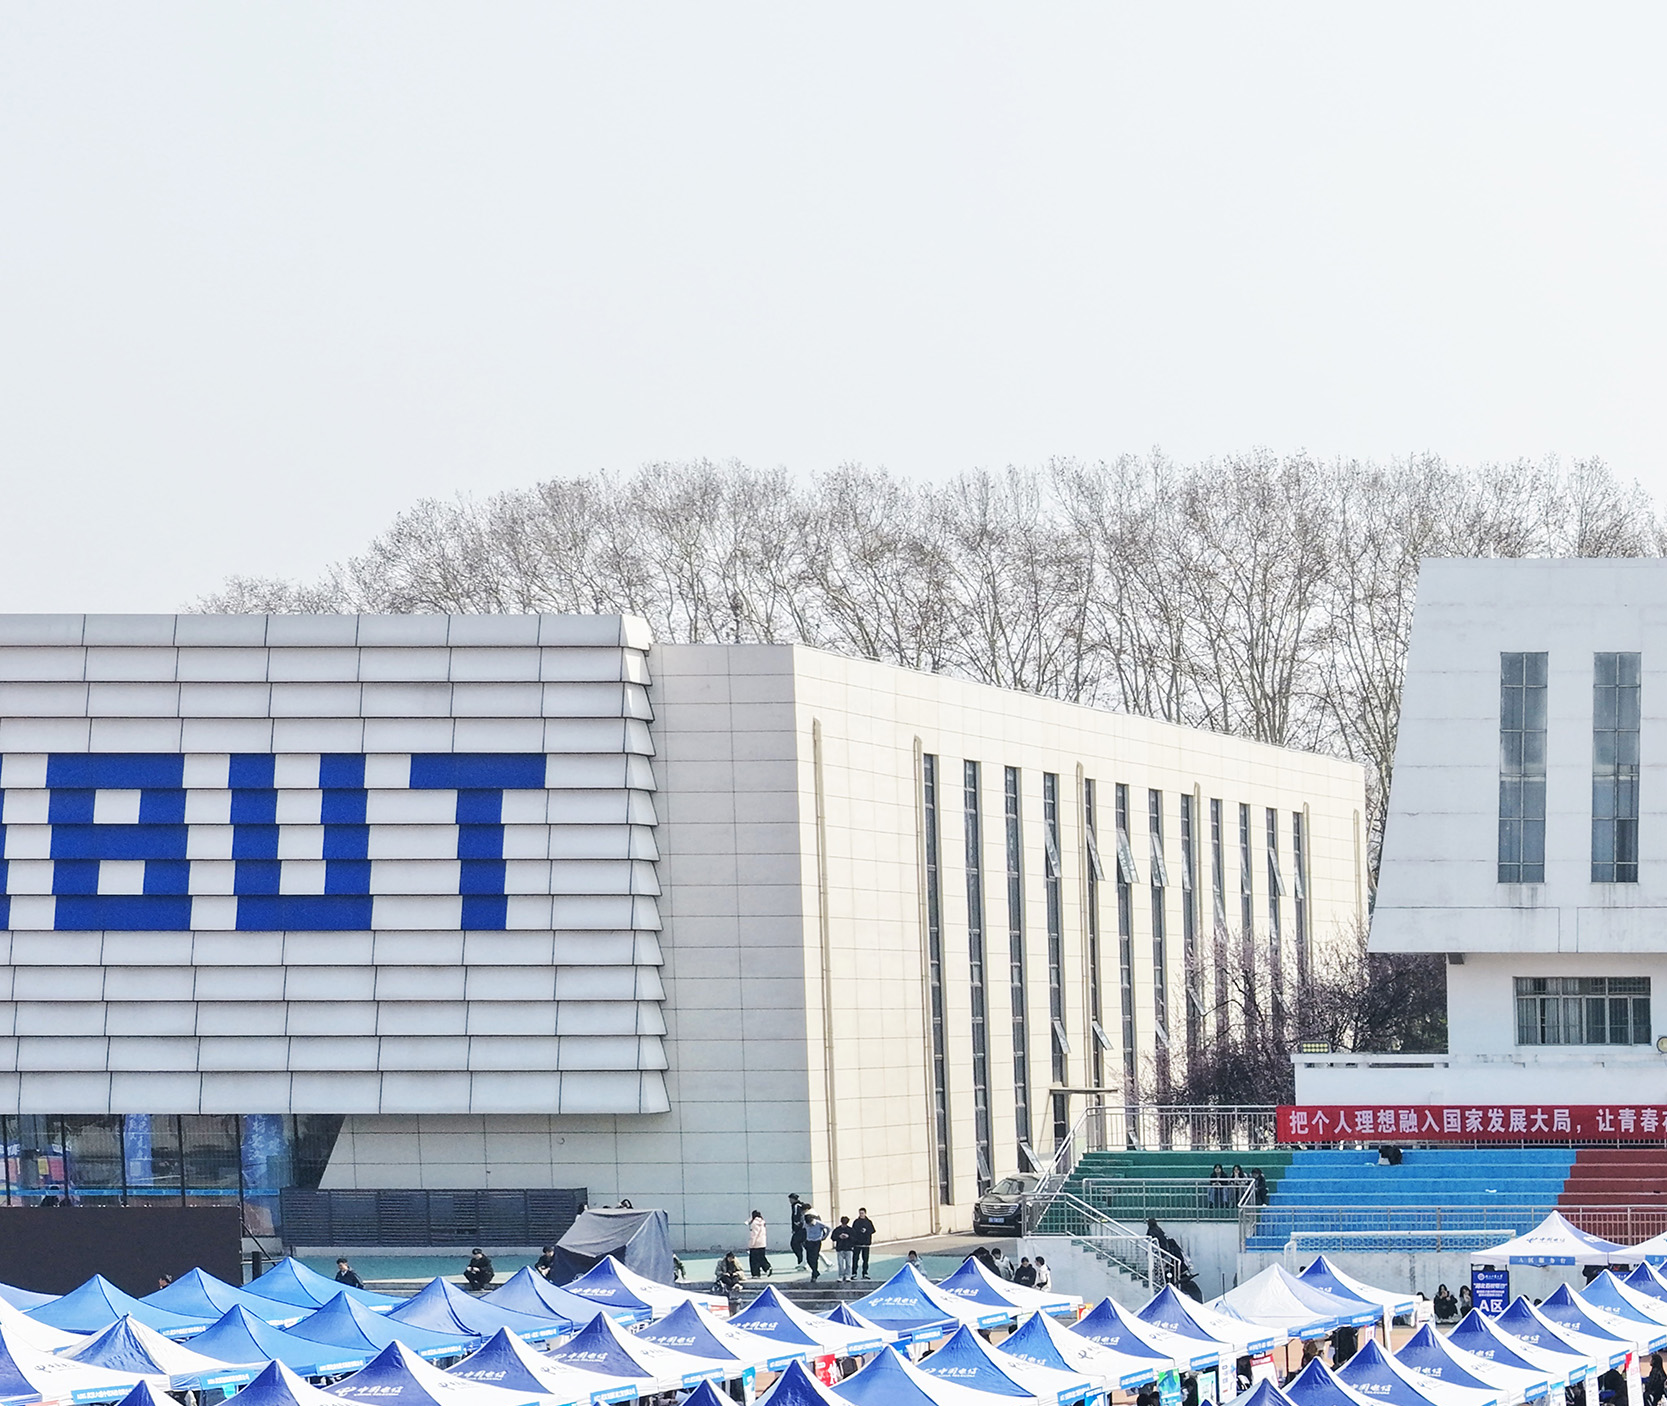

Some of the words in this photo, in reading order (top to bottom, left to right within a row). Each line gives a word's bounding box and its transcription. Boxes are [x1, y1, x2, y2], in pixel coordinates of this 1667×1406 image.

[0, 753, 546, 931] BUT
[360, 1385, 404, 1397] 中国电信
